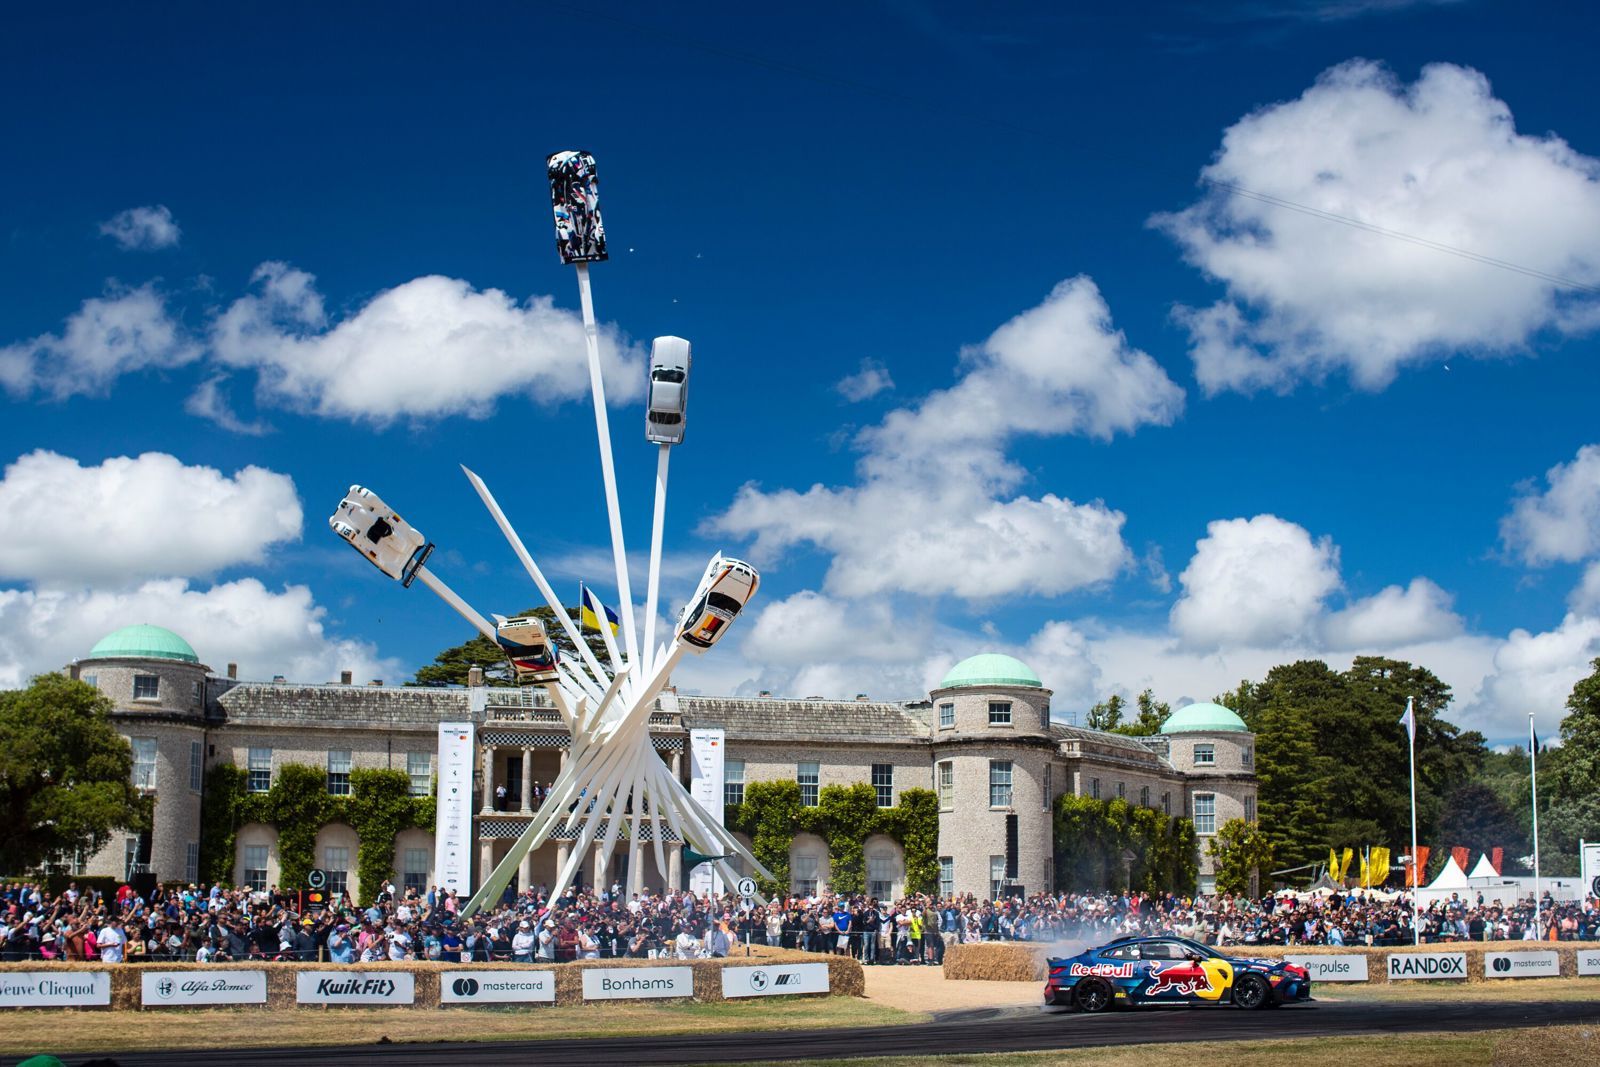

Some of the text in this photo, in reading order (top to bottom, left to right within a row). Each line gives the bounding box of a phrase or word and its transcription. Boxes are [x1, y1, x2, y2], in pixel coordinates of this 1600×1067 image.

[744, 882, 750, 893] 4
[1070, 962, 1134, 977] Red Bull
[1319, 960, 1350, 975] pulse
[1391, 957, 1463, 974] RANDOX
[38, 980, 95, 998] Clicquot
[181, 980, 253, 996] Alfa Romeo
[483, 981, 543, 990] mastercard
[602, 977, 674, 991] Bonhams
